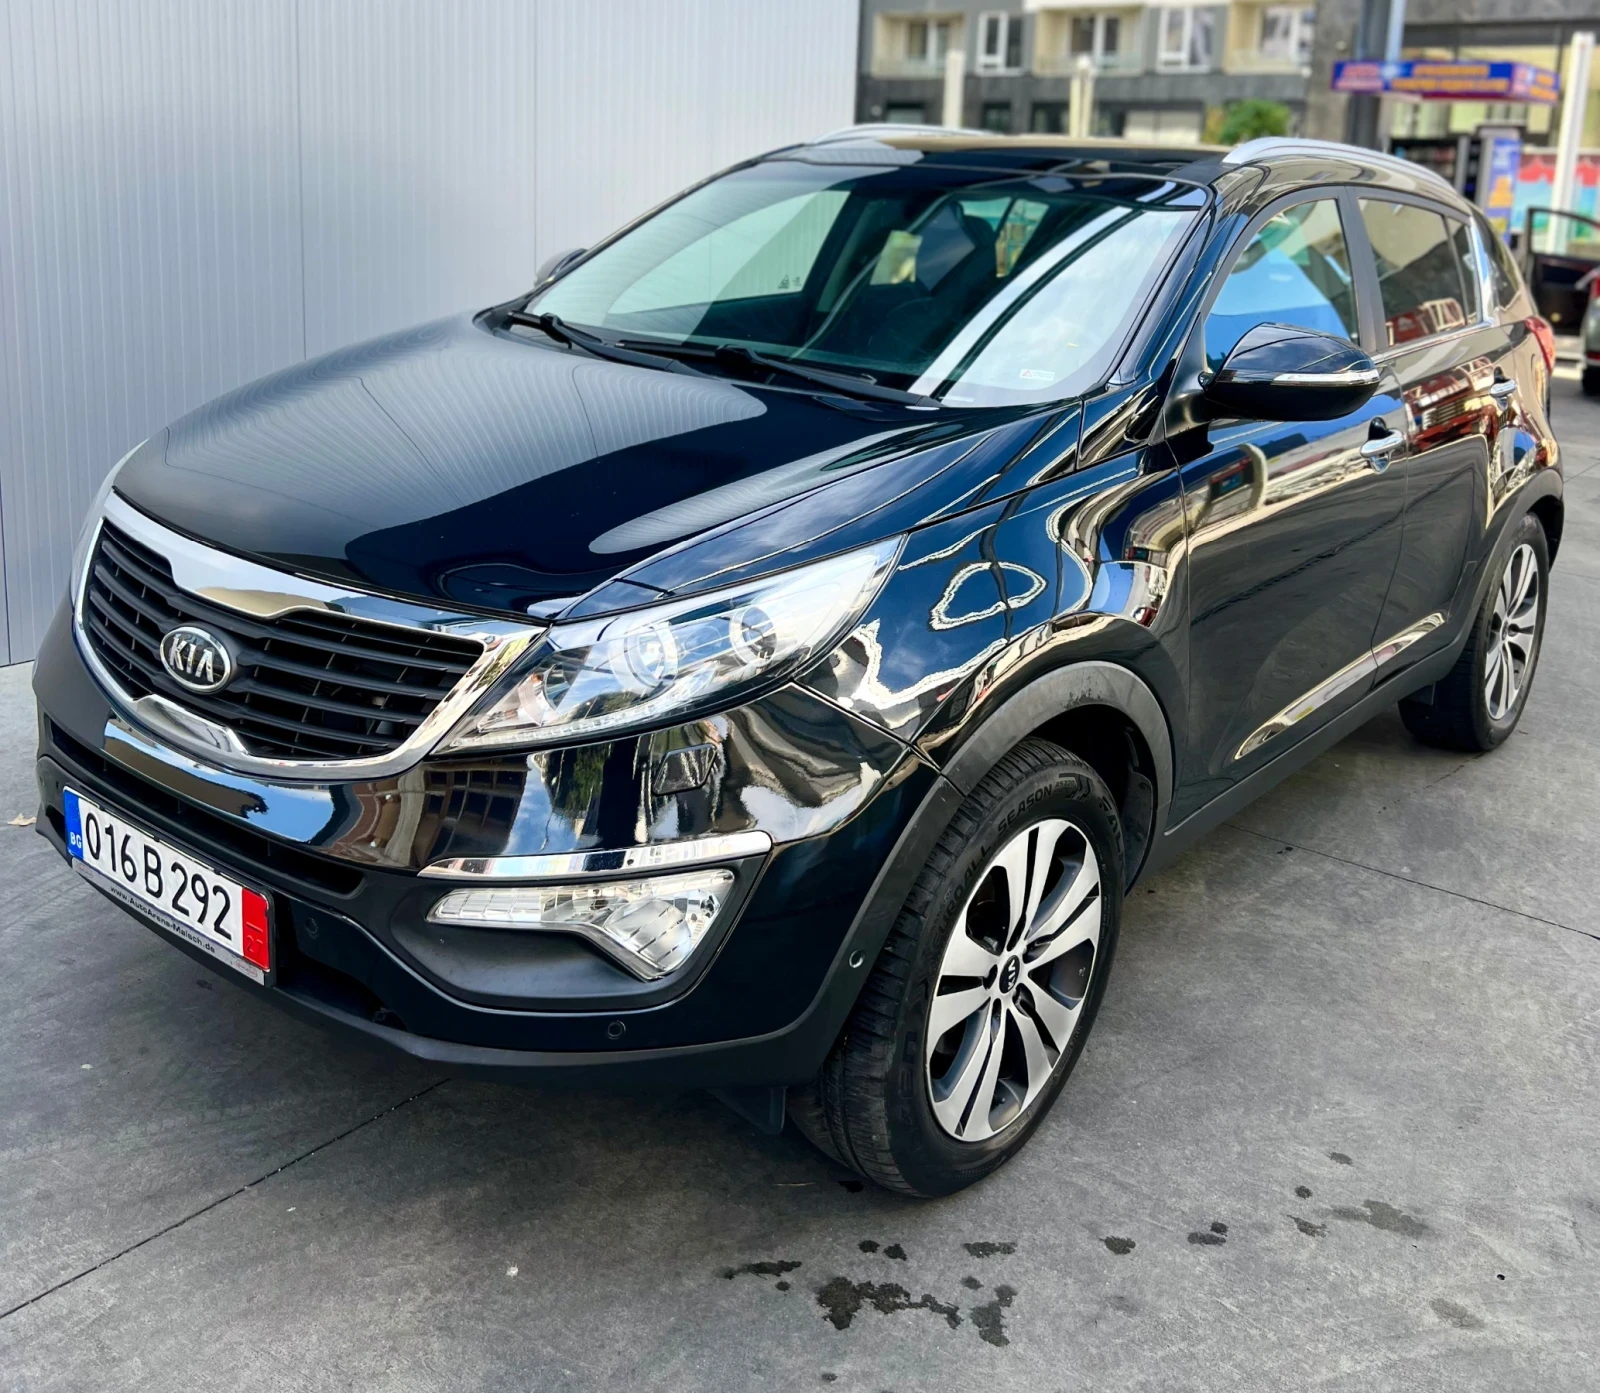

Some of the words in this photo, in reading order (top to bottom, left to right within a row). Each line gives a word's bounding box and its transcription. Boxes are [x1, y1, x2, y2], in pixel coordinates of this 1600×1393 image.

[169, 633, 214, 683] KIA
[997, 783, 1053, 835] SEASON
[69, 831, 82, 849] BG
